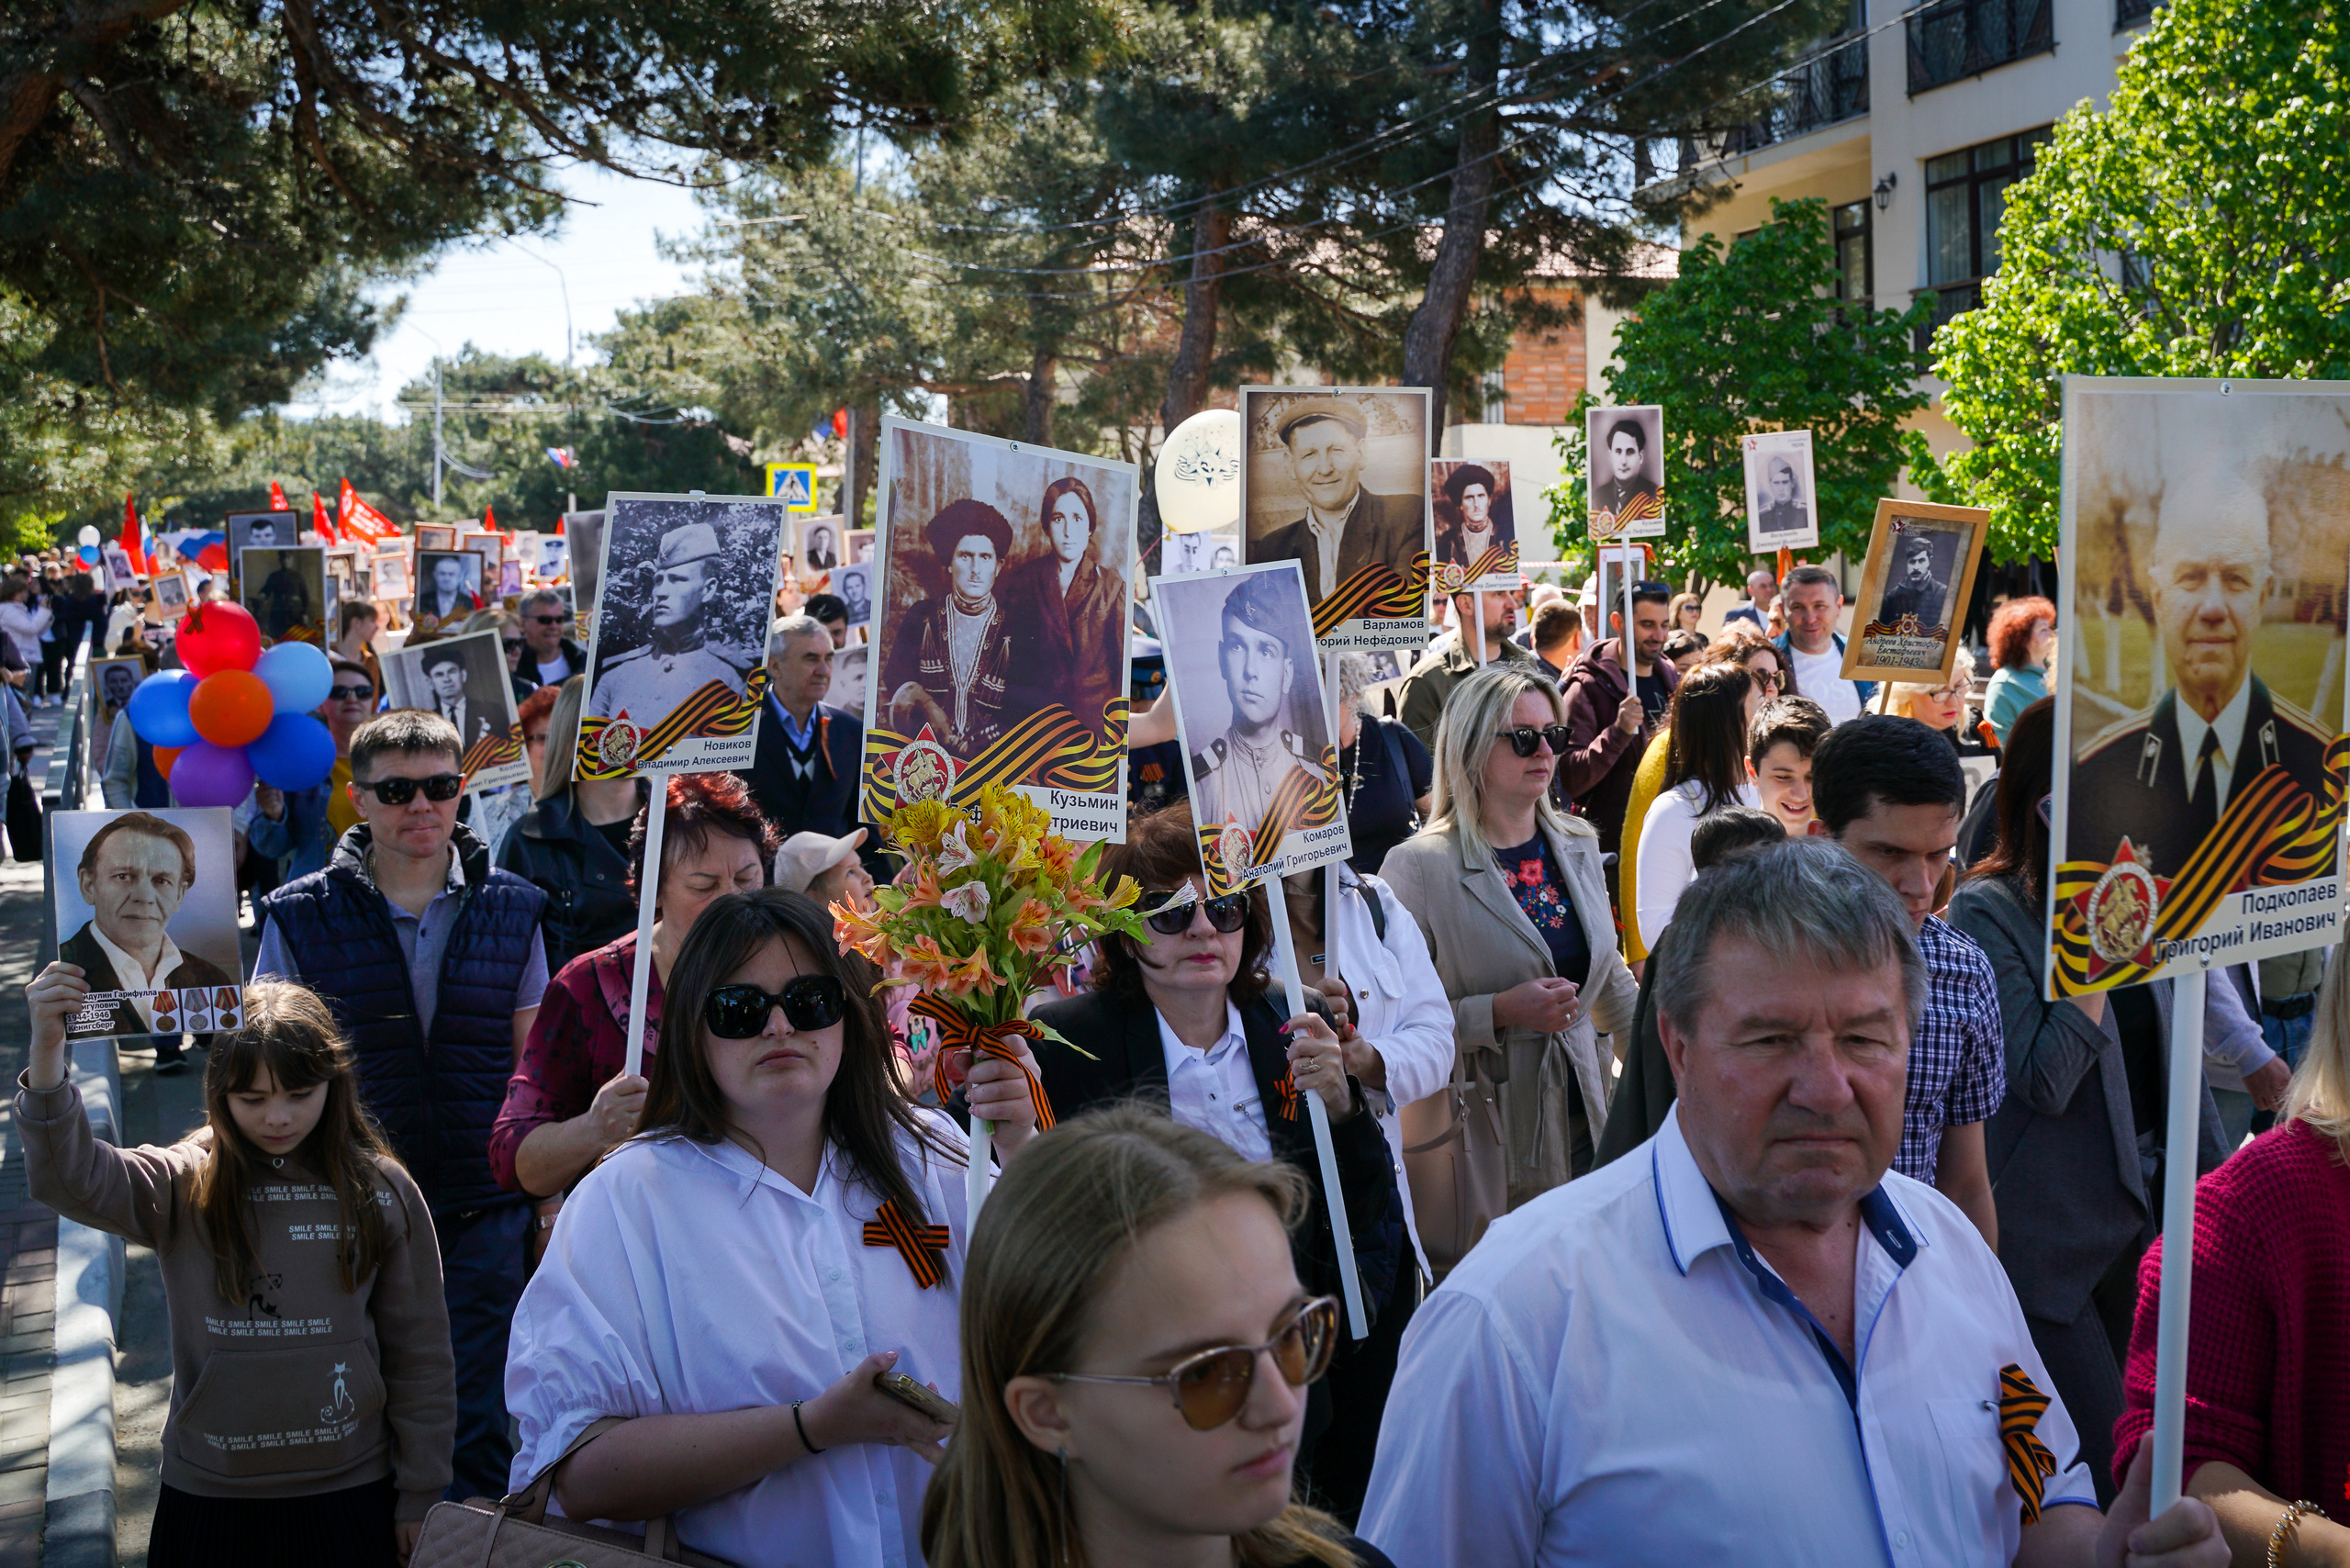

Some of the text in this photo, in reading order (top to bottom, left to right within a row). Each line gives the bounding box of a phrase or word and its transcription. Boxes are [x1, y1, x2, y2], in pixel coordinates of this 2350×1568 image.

[1363, 620, 1424, 632] Варламов
[1316, 634, 1424, 648] горий Нефёдович
[1866, 636, 1941, 649] Андреев Христофор
[1876, 644, 1927, 656] Евстафьевич
[704, 740, 752, 751] Новиков
[499, 761, 527, 772] Козлов
[637, 755, 750, 770] Владимир Алексеевич
[1050, 790, 1118, 812] Кузьмин
[1051, 816, 1118, 834] триевич
[1303, 824, 1345, 844] Комаров
[1241, 841, 1348, 882] Анатолий Григорьевич
[2242, 882, 2337, 915] Подкопаев
[2154, 912, 2336, 964] Григорий Иванович
[84, 989, 157, 1002] идулин Гарифулла
[82, 1002, 118, 1011] игулович
[67, 1011, 109, 1023] 1944-1946
[68, 1021, 114, 1032] Кенигсберг
[264, 1185, 288, 1194] SMILE
[291, 1184, 316, 1193] SMILE
[318, 1184, 336, 1193] SMIL
[267, 1193, 291, 1202] SMILE
[294, 1193, 318, 1201] SMILE
[320, 1192, 338, 1201] SMIL
[288, 1224, 312, 1233] SMILE
[315, 1224, 339, 1232] SMILE
[291, 1232, 315, 1241] SMILE
[205, 1316, 330, 1328] SMILE SMILE SMILE SMILE SMILE
[207, 1325, 332, 1337] SMILE SMILE SMILE SMILE SMILE
[204, 1432, 225, 1443] SMILE
[228, 1435, 253, 1444] SMILE
[256, 1432, 283, 1441] SMILE
[285, 1428, 311, 1439] SMILE
[314, 1426, 340, 1436] SMILE
[207, 1439, 228, 1450] SMILE
[230, 1442, 256, 1450] SMILE
[260, 1439, 285, 1448] SMILE
[288, 1436, 314, 1445] SMILE
[317, 1433, 342, 1442] SMILE
